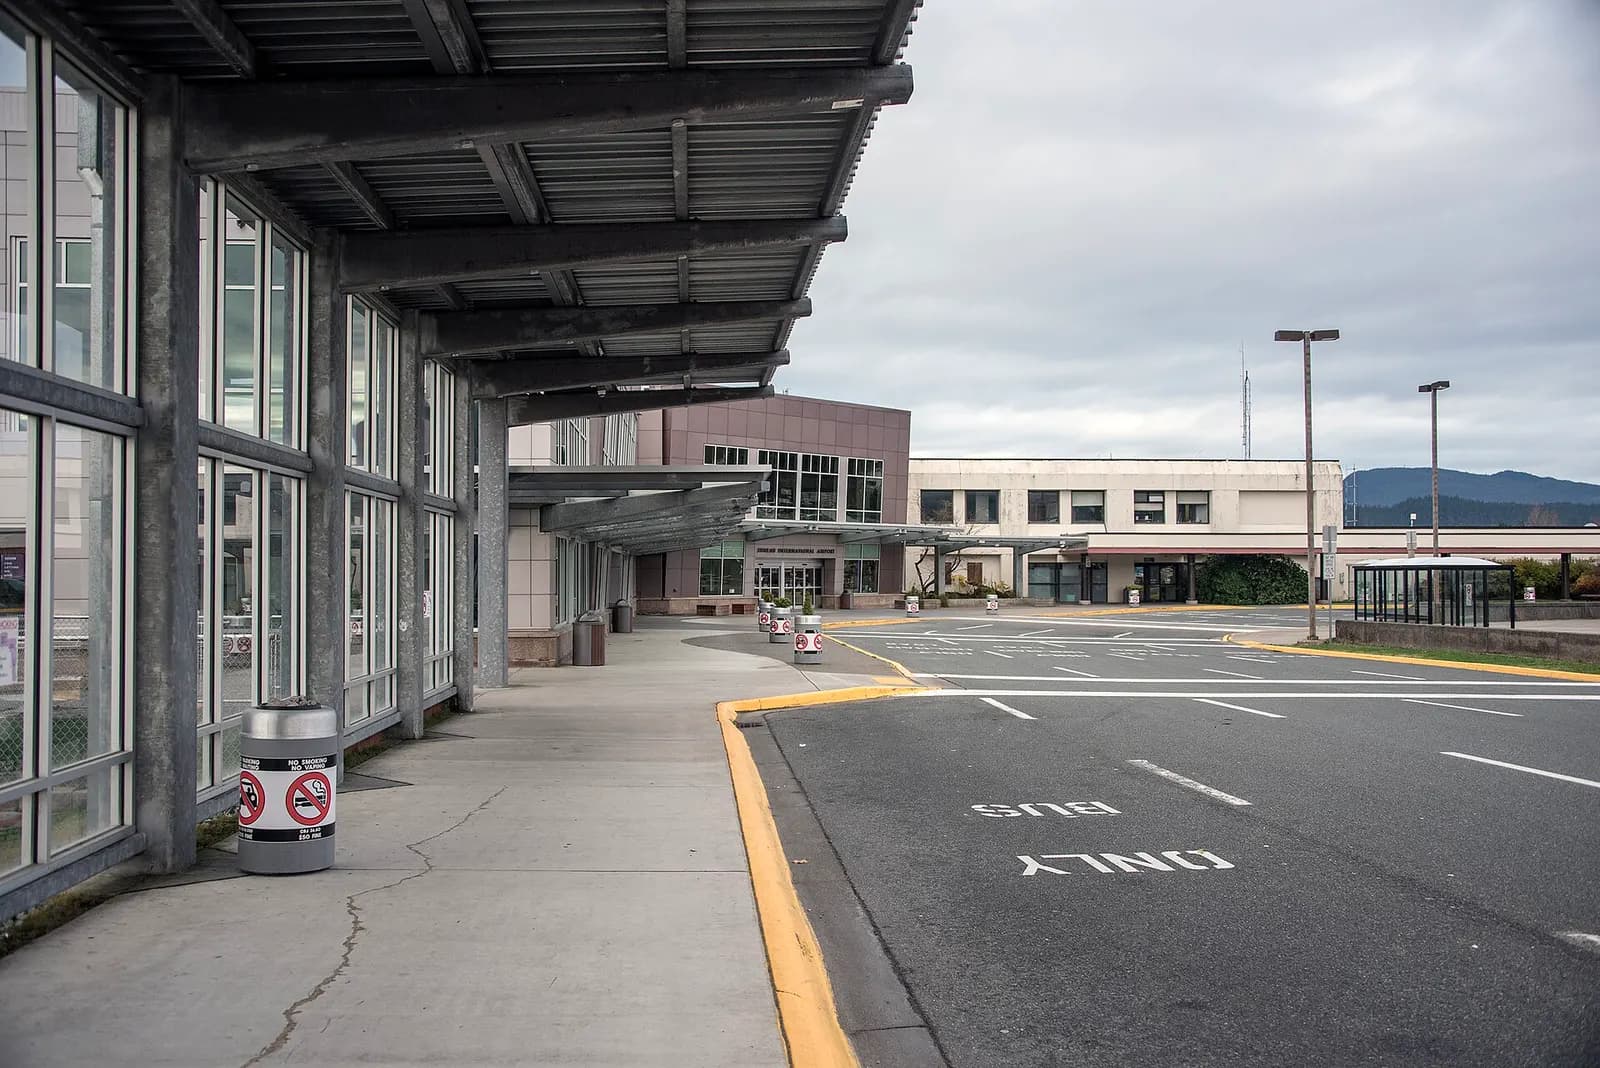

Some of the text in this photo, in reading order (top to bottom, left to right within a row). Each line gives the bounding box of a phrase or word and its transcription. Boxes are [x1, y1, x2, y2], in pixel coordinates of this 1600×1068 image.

[301, 757, 327, 765] SMOKING
[971, 800, 1123, 819] BUS
[1016, 849, 1236, 876] ONLY
